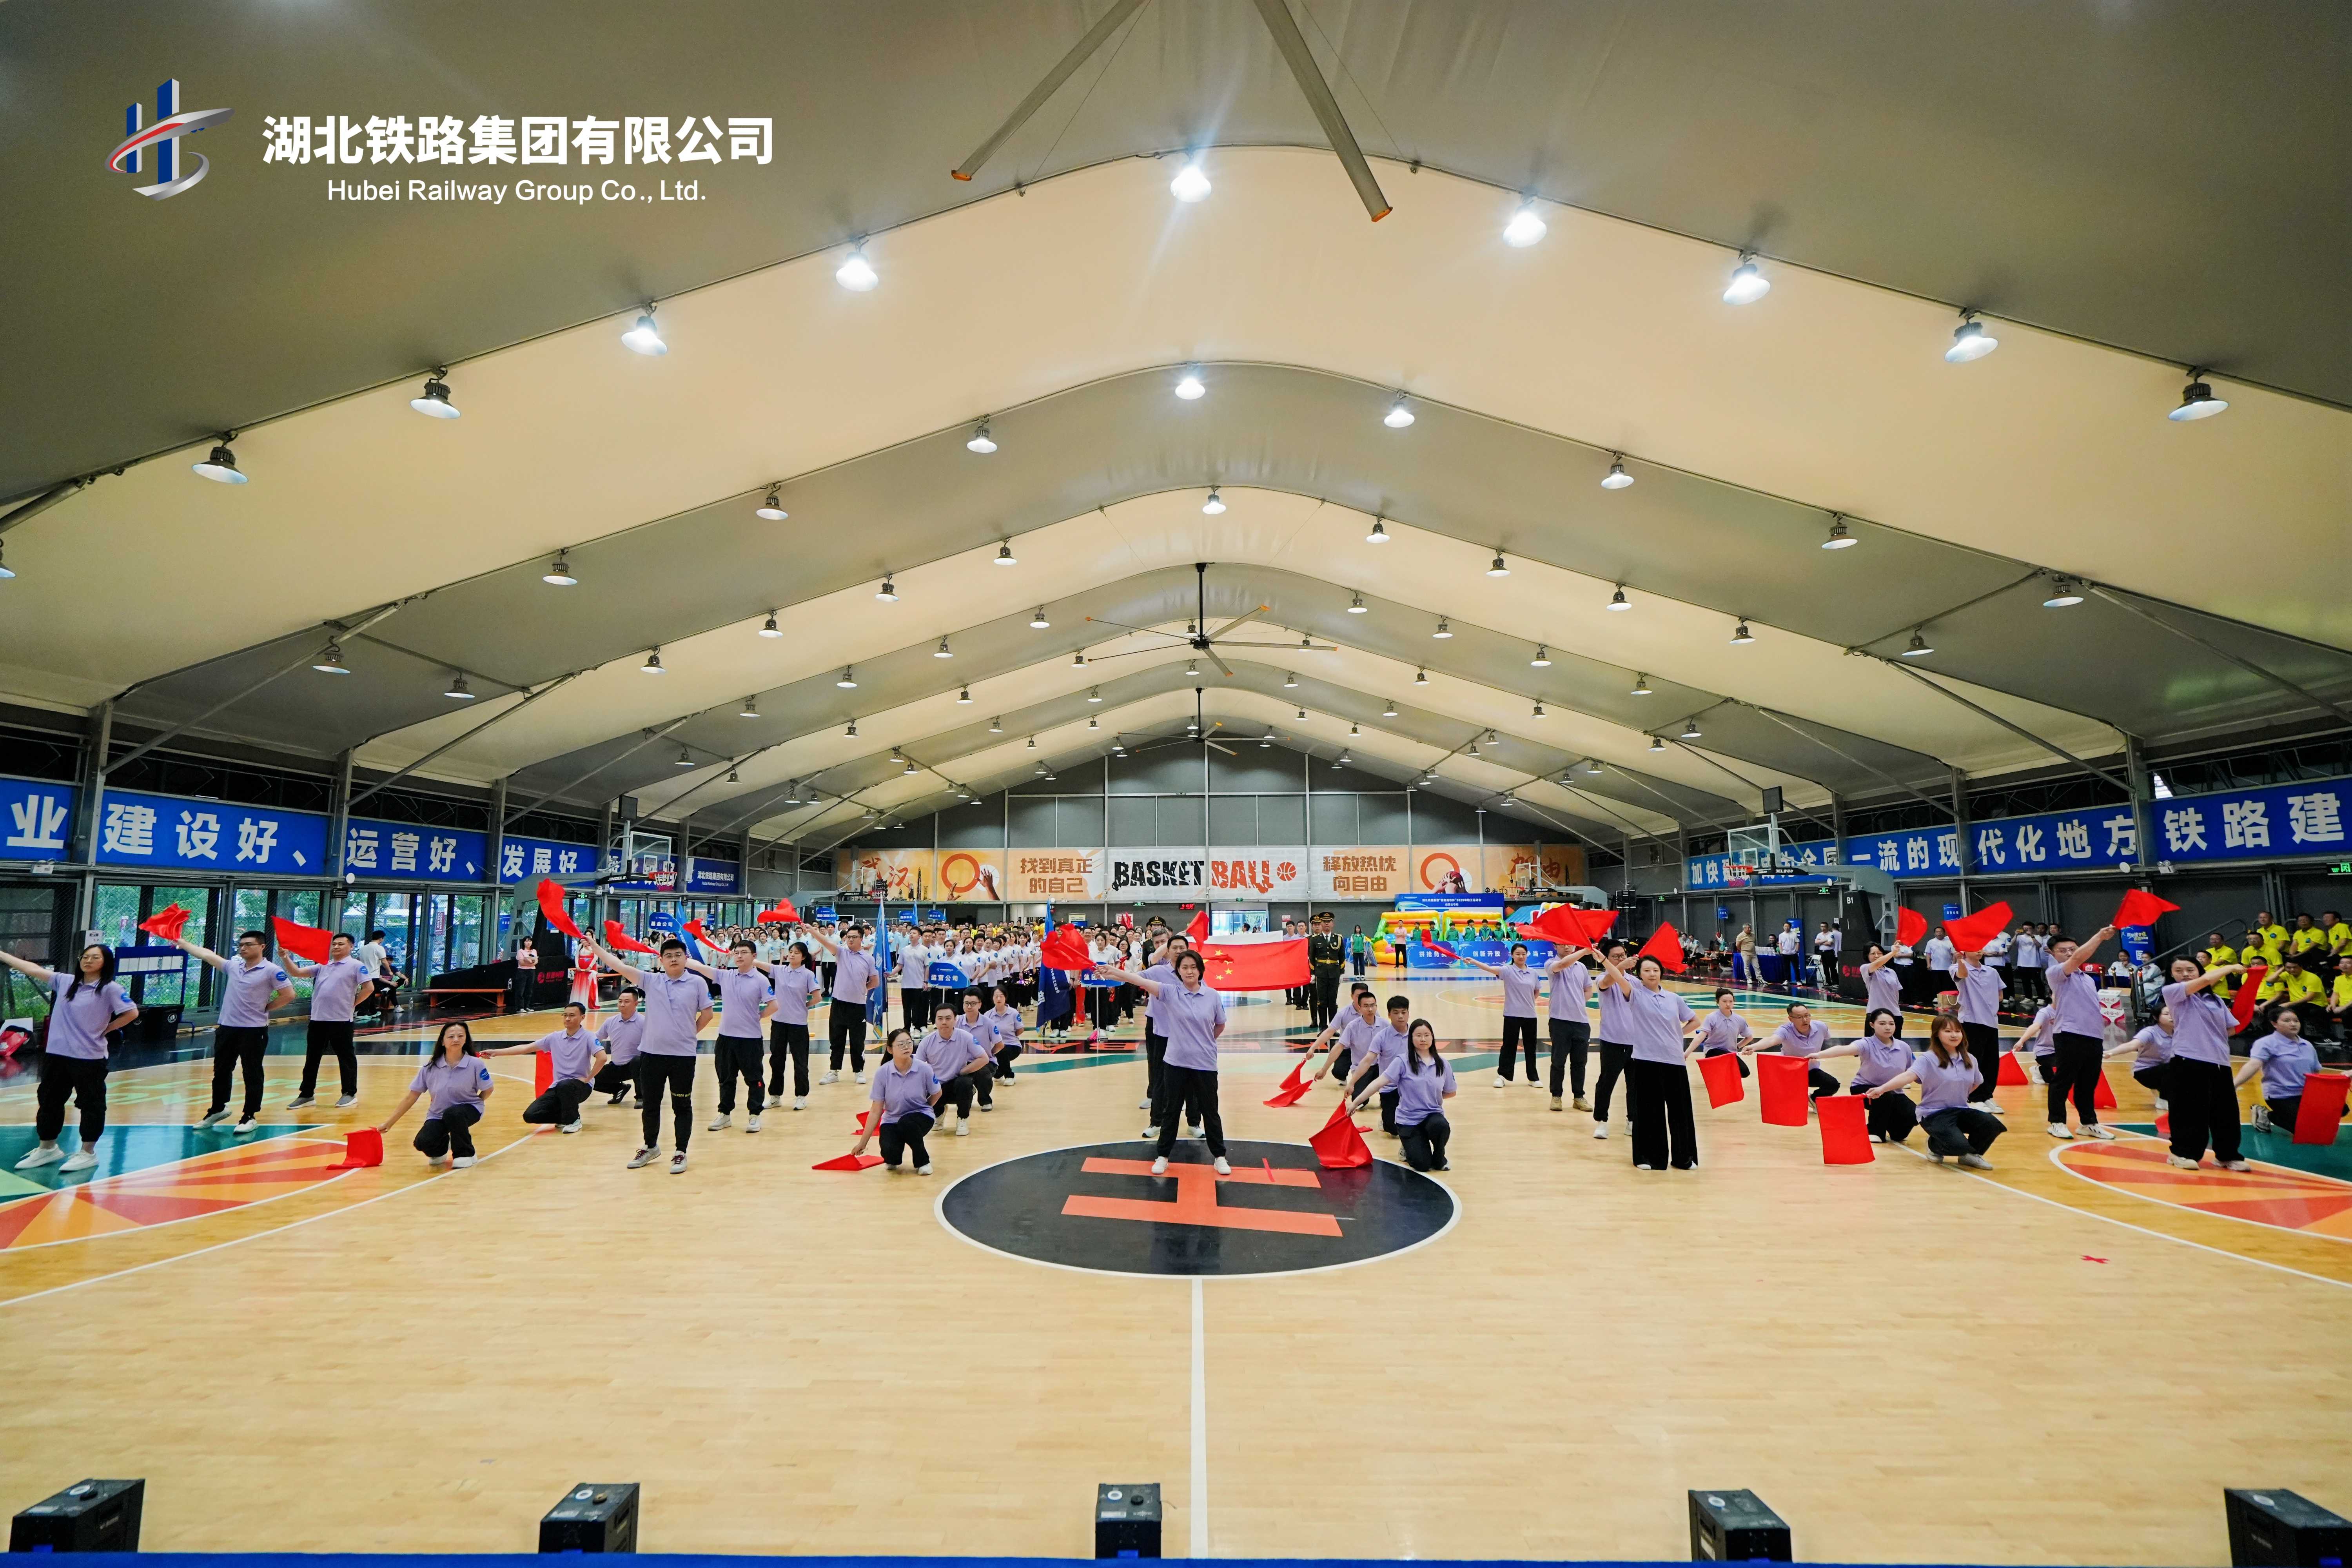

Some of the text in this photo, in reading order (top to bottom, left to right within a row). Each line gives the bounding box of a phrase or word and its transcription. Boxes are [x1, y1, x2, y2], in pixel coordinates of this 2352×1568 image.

[6, 795, 67, 849] 业
[102, 804, 307, 867] 建设好、
[1978, 815, 2136, 865] 代化地方
[2164, 793, 2344, 852] 铁路建
[346, 828, 475, 874] 运营好、
[503, 844, 577, 878] 发展好
[1020, 858, 1093, 874] 找到真正
[1852, 833, 1960, 871] 一流的现
[697, 871, 734, 881] 湖北铁路集团有限公司
[1029, 877, 1083, 893] 的自己
[1333, 875, 1387, 891] 向自由
